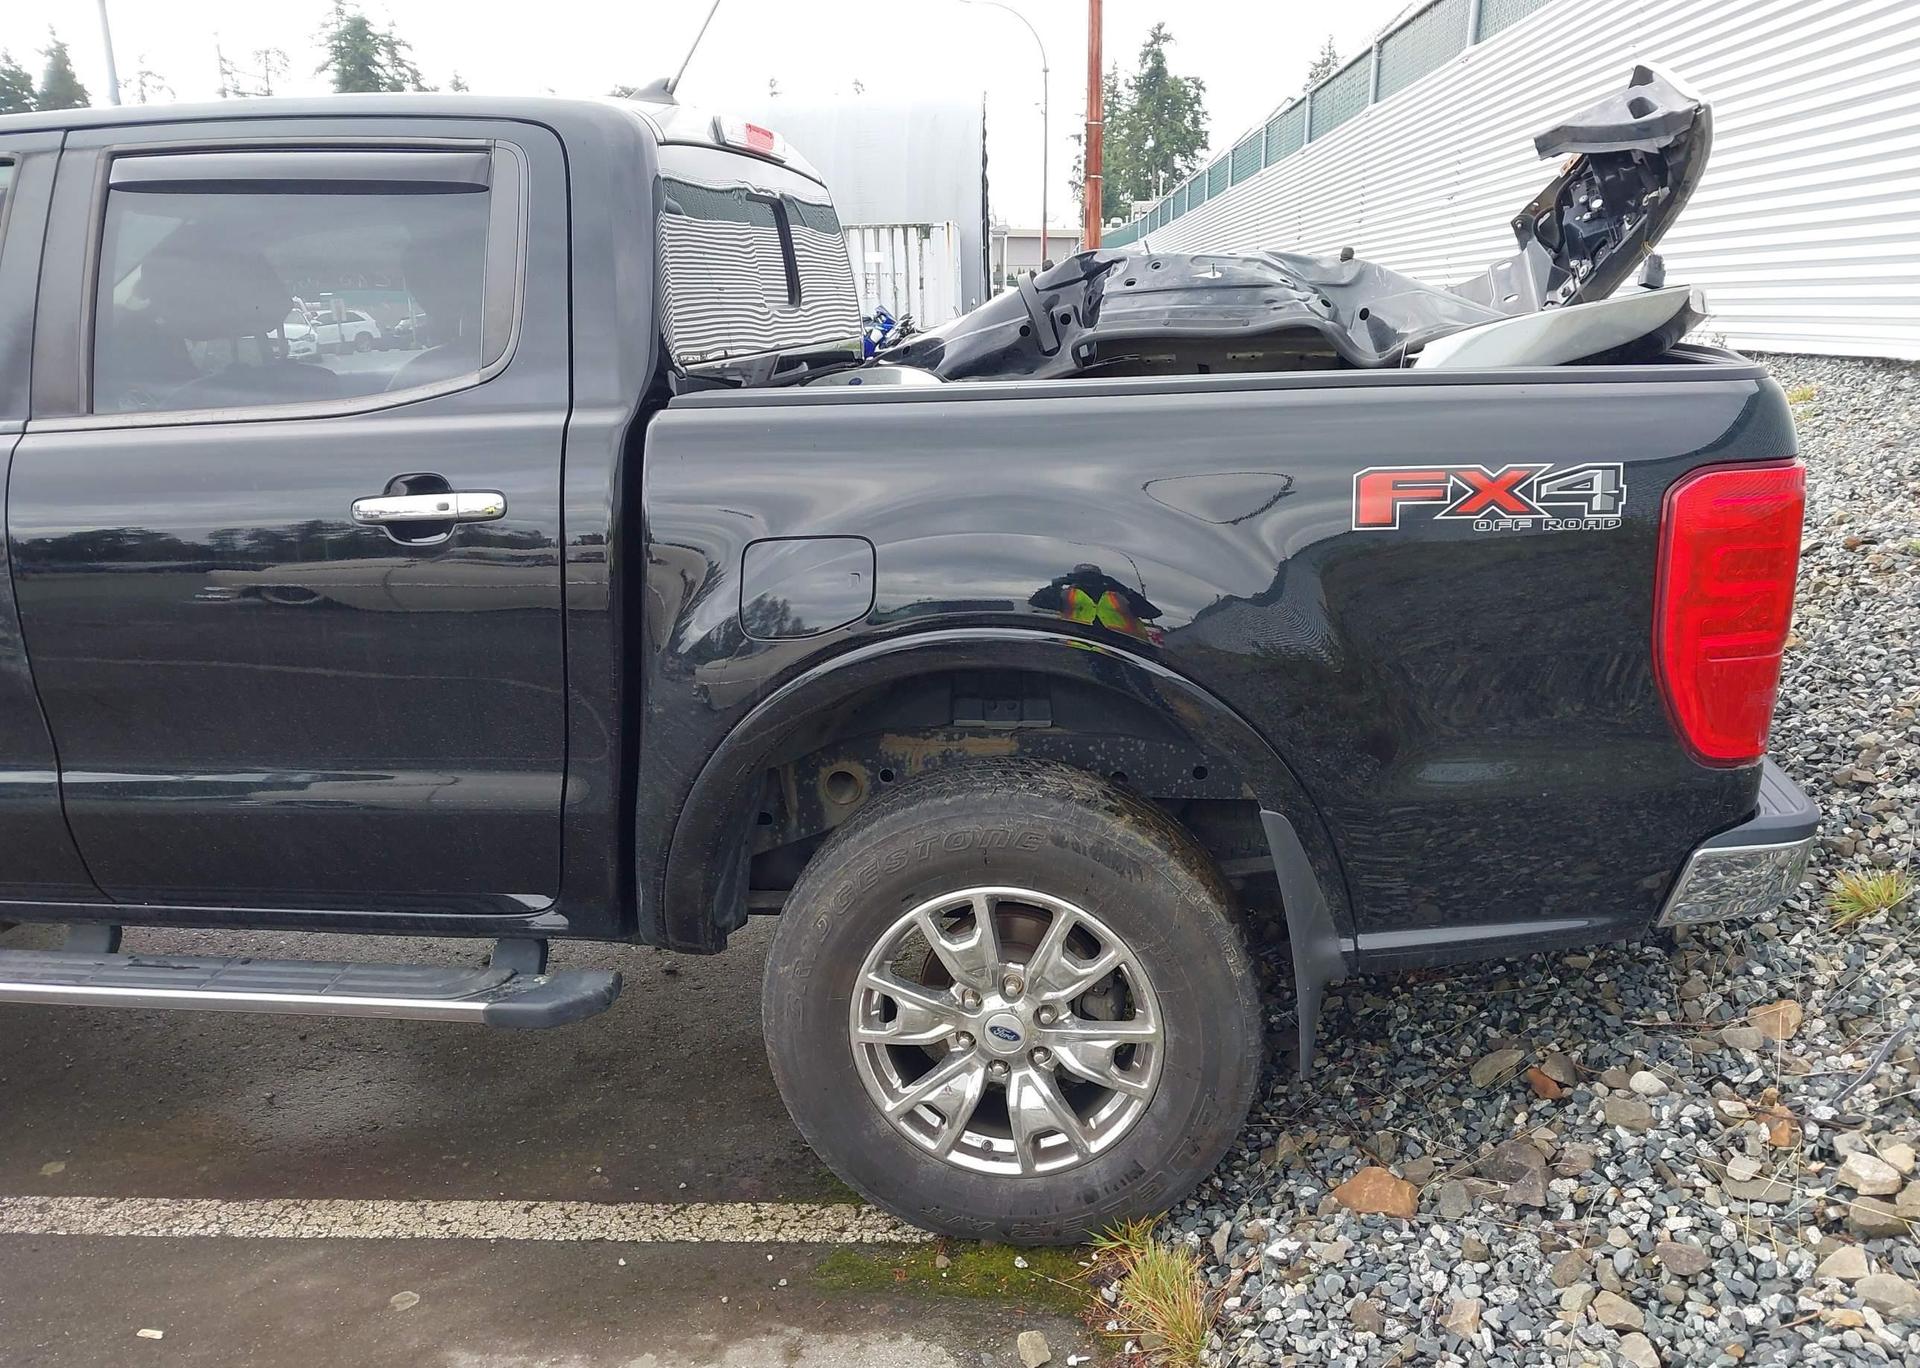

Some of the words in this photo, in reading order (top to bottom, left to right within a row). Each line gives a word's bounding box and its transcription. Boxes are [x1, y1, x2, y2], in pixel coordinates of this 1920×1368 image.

[1352, 463, 1627, 531] FX4
[1473, 518, 1533, 532] OFF
[1542, 517, 1622, 531] ROAD
[991, 1026, 1019, 1041] Ford
